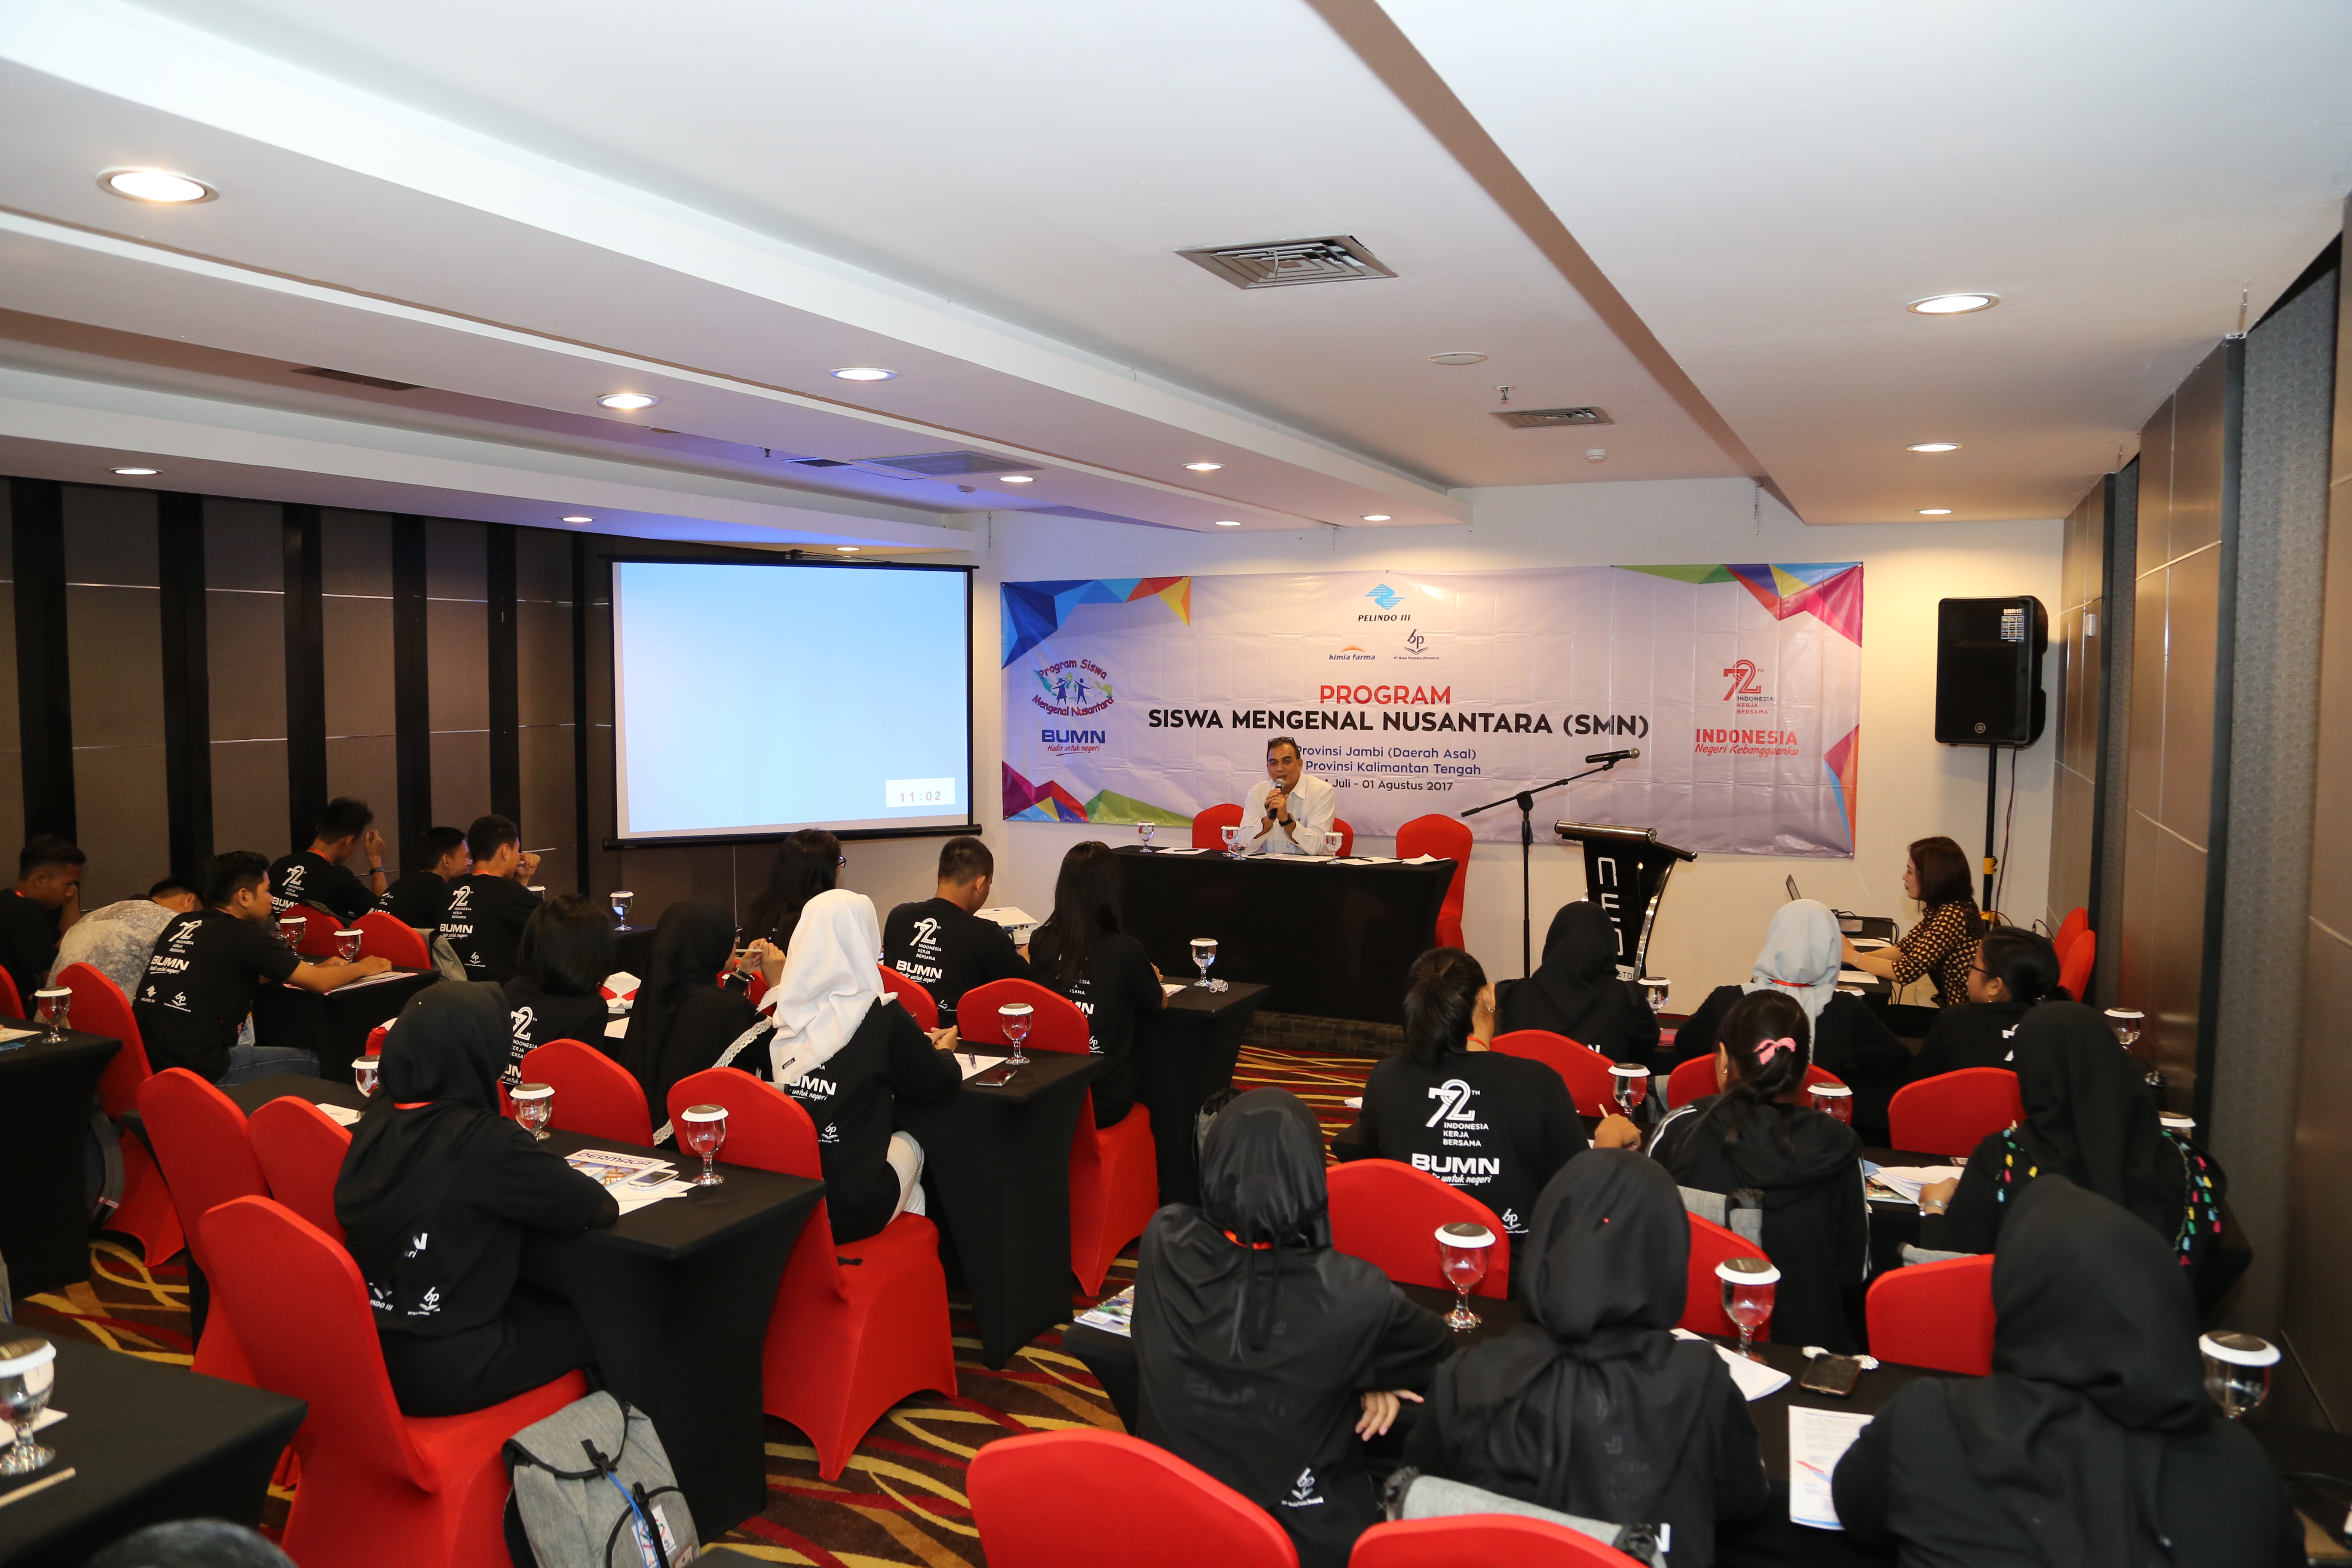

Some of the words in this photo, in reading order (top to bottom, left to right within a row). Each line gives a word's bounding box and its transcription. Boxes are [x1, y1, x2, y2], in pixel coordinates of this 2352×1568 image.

[1038, 660, 1077, 678] Program
[1080, 659, 1107, 679] Siswa
[1723, 659, 1761, 701] 72
[1320, 685, 1451, 705] PROGRAM
[1032, 695, 1069, 716] Mengenal
[1072, 697, 1114, 717] Nusantara
[1149, 709, 1223, 728] SISWA
[1232, 710, 1373, 730] MENGENAL
[1383, 711, 1553, 734] NUSANTARA
[1563, 714, 1649, 739] (SMN)
[1042, 729, 1106, 744] BUMN
[1696, 729, 1798, 745] INDONESIA
[1081, 744, 1100, 753] negeri
[1297, 746, 1341, 756] Provinsi
[1346, 747, 1383, 757] Jambi
[1387, 747, 1439, 759] (Daerah
[1443, 749, 1476, 760] Asal)
[1695, 744, 1727, 756] Negeri
[1730, 744, 1800, 757] Kebanggaanku
[1306, 761, 1353, 771] Provinsi
[1357, 762, 1429, 774] Kalimantan
[1433, 763, 1481, 776] Tengah
[1332, 778, 1351, 788] Juli
[1362, 780, 1374, 789] 01
[1378, 781, 1423, 791] Agustus
[1427, 782, 1454, 791] 2017
[272, 897, 298, 908] BUM
[440, 923, 473, 934] BUMN
[918, 943, 942, 952] INDONESIA
[150, 955, 190, 971] BUMN
[896, 960, 943, 979] BUMN
[513, 1039, 538, 1049] NDONESIA
[808, 1093, 828, 1101] negeri
[1425, 1078, 1476, 1127] 72
[1443, 1122, 1489, 1130] INDONESIA
[1443, 1130, 1469, 1138] KERJA
[1442, 1138, 1482, 1147] BERSAMA
[576, 1152, 653, 1166] DERMAGA
[1411, 1153, 1500, 1175] BUMN
[1465, 1175, 1492, 1186] negeri
